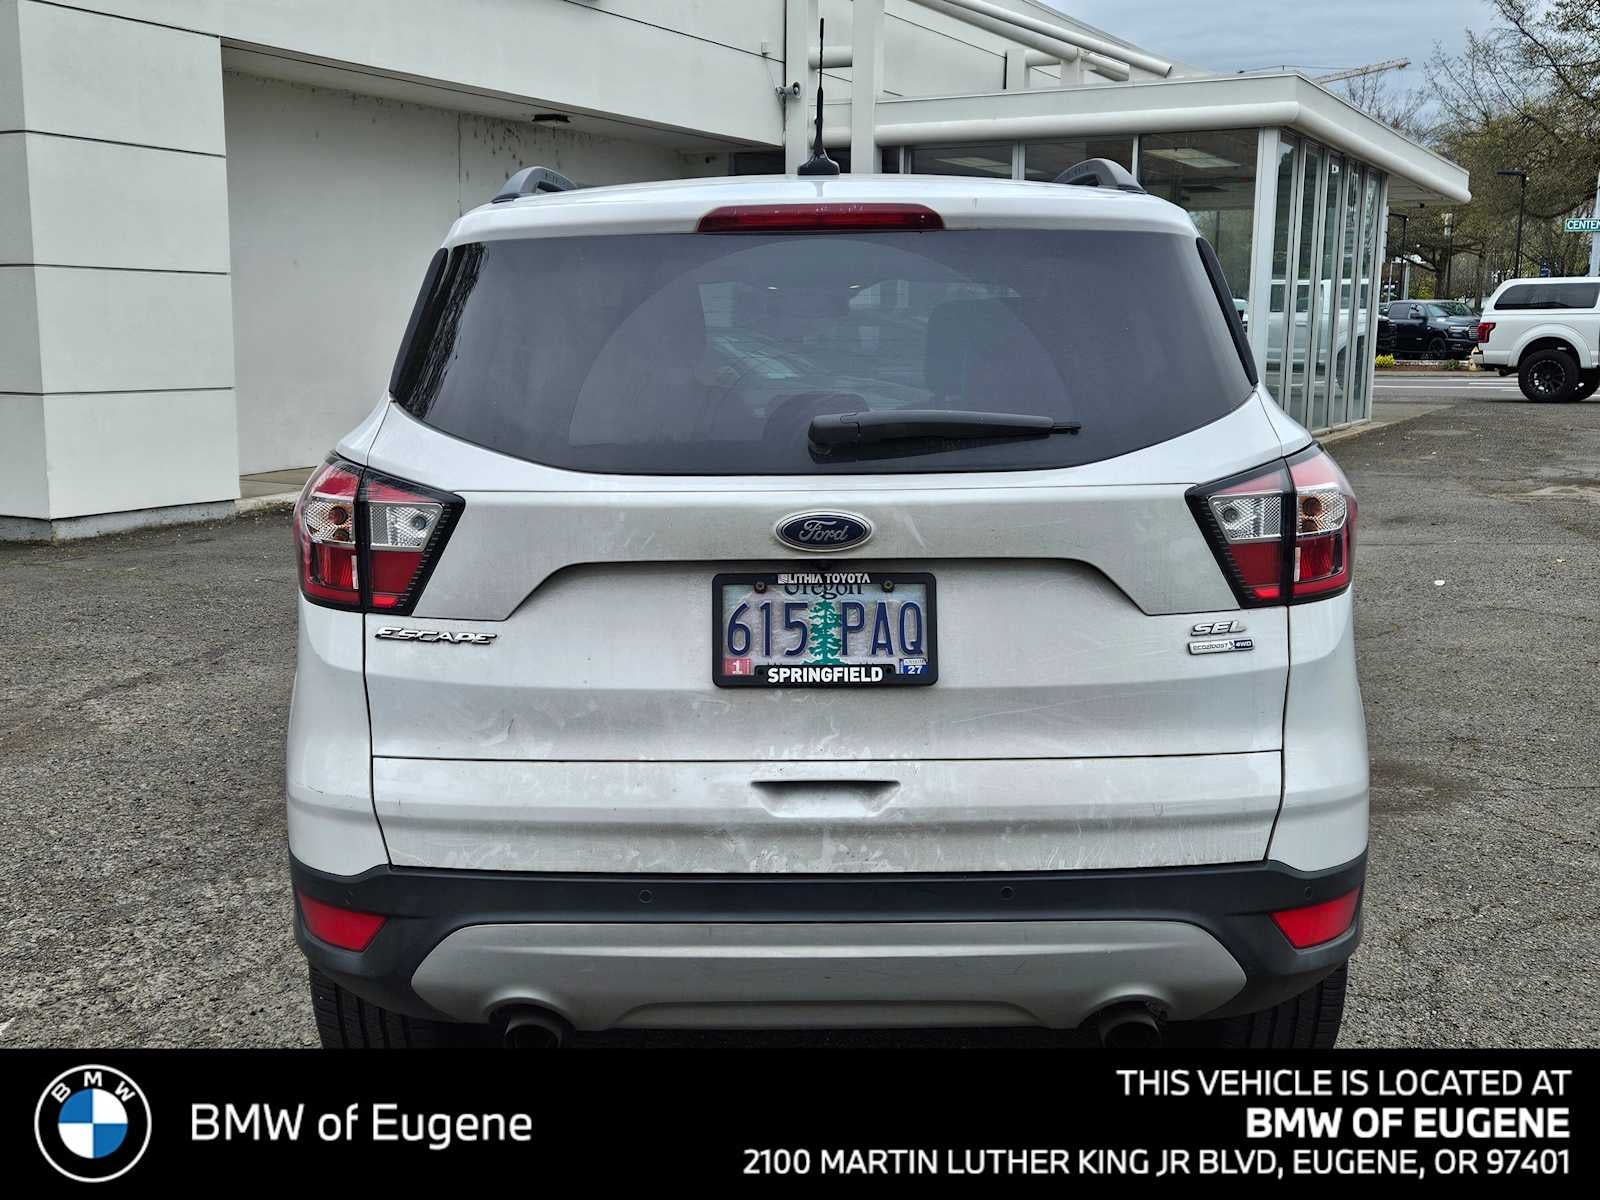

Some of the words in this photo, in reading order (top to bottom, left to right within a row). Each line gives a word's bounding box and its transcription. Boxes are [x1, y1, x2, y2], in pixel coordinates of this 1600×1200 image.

[799, 520, 849, 541] Ford
[788, 573, 823, 584] LITHIA
[825, 573, 871, 584] TOYOTA
[375, 626, 497, 645] ESCAPE
[727, 601, 809, 657] 615
[841, 601, 923, 657] PAQ
[1191, 620, 1247, 636] SEL
[767, 667, 884, 683] SPRINGFIELD
[907, 665, 922, 675] 27
